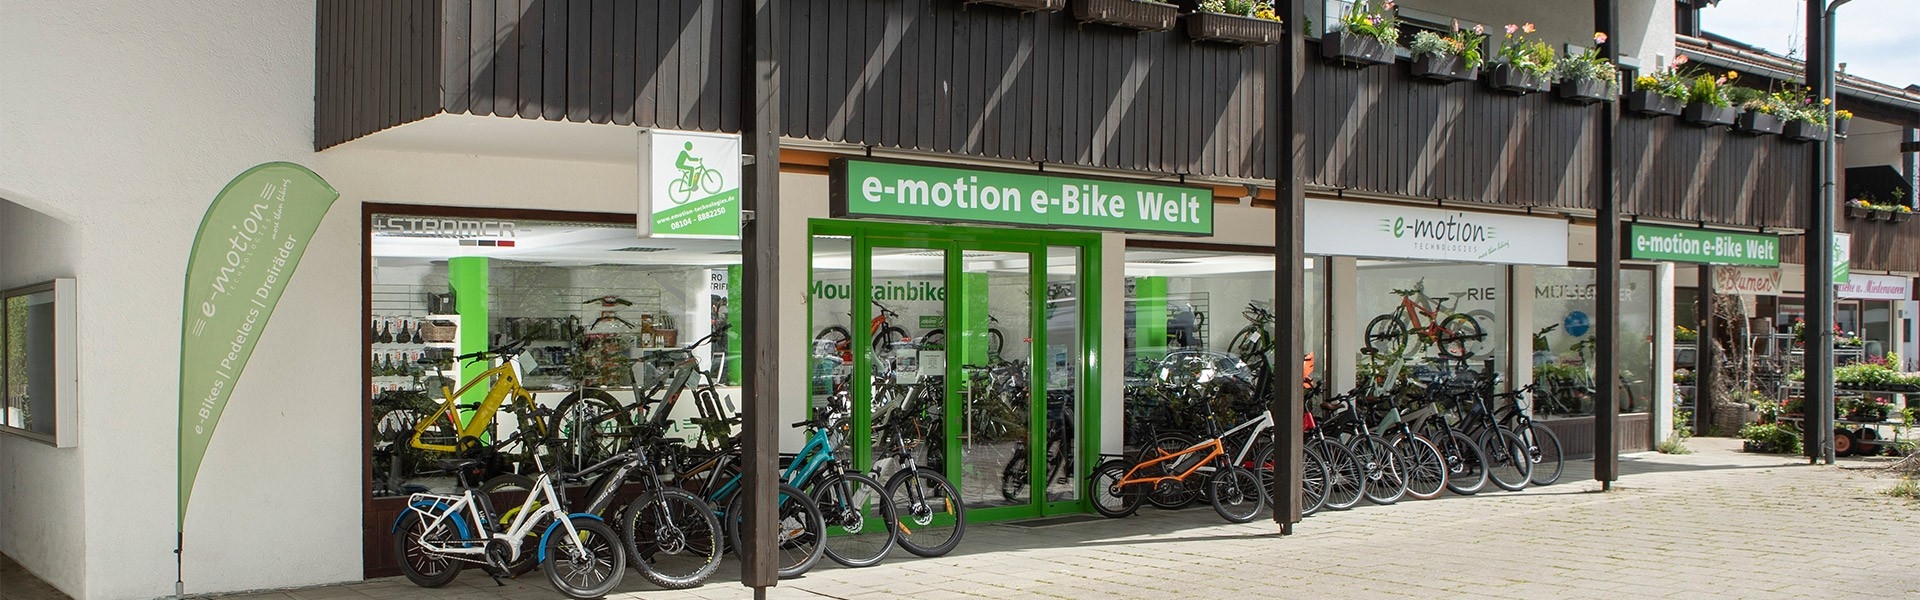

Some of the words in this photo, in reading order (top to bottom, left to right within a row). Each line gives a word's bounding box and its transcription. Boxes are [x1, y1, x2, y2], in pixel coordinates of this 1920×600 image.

[656, 195, 735, 224] www.emotion-technologies.de
[861, 175, 1021, 213] e-motion
[1031, 184, 1125, 219] e-Bike
[1137, 190, 1201, 224] Welt
[670, 218, 692, 230] 08104
[697, 207, 726, 222] 8882250
[1393, 212, 1486, 243] e-motion
[202, 203, 269, 318] e-motion
[227, 219, 271, 296] TECHNOLOGIES
[1414, 242, 1478, 253] TECHNOLOGIES
[1637, 233, 1700, 255] e-motion
[1702, 236, 1742, 258] e-Bike
[1746, 239, 1774, 260] Welt
[1725, 267, 1772, 292] Blumen
[195, 379, 224, 435] e-Bikes
[220, 307, 259, 370] Pedelecs
[256, 234, 297, 299] Dreiräder
